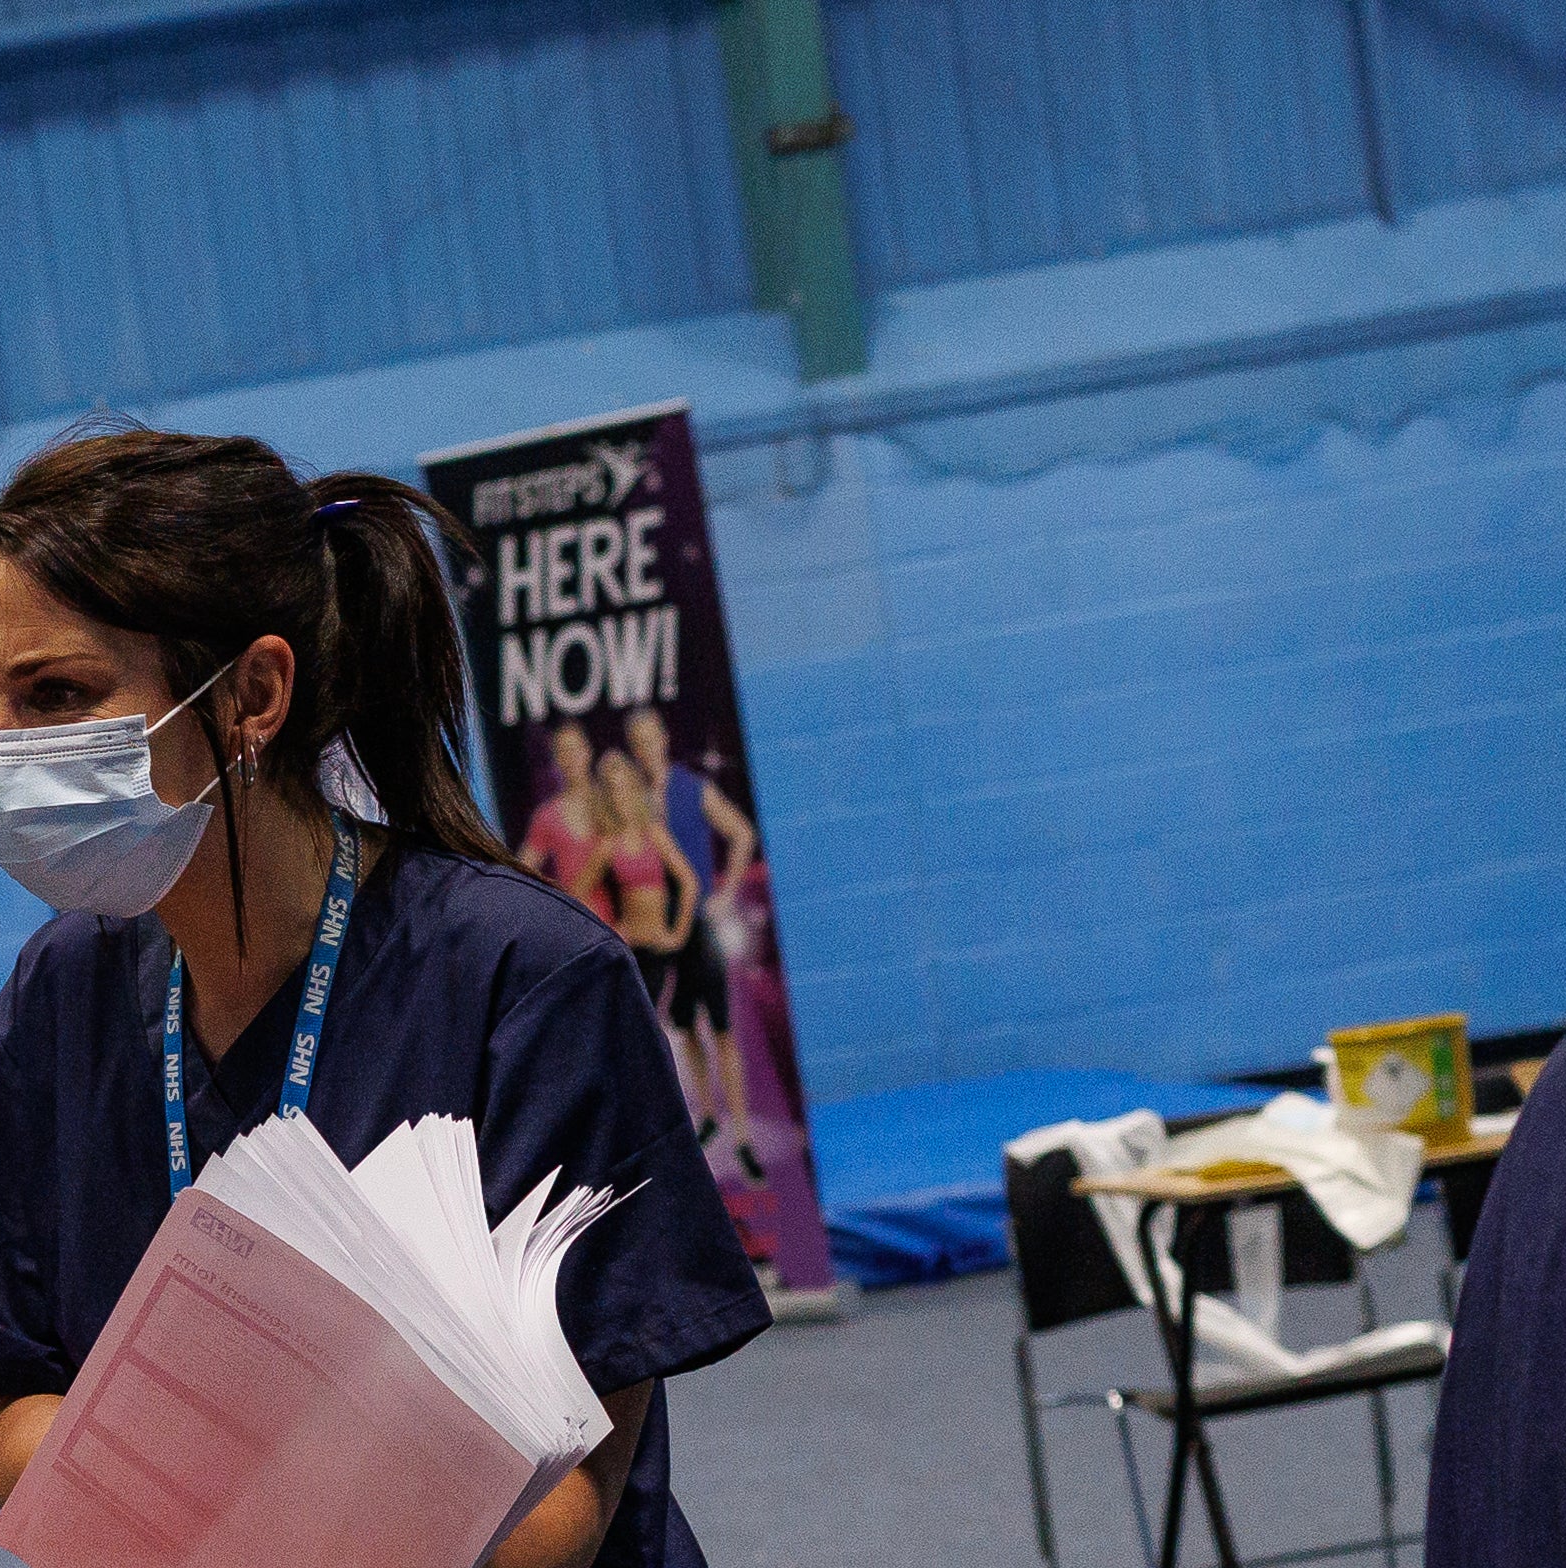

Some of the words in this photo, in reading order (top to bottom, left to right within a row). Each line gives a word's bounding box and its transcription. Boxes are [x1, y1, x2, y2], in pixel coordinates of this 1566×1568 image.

[497, 505, 667, 627] HERE
[499, 603, 681, 727] NOW!
[168, 987, 181, 1034] NHS
[289, 1033, 315, 1086] NHS
[303, 963, 330, 1015] NHS
[319, 897, 347, 946] NHS
[166, 1054, 179, 1102] NHS
[169, 1122, 186, 1172] NHS
